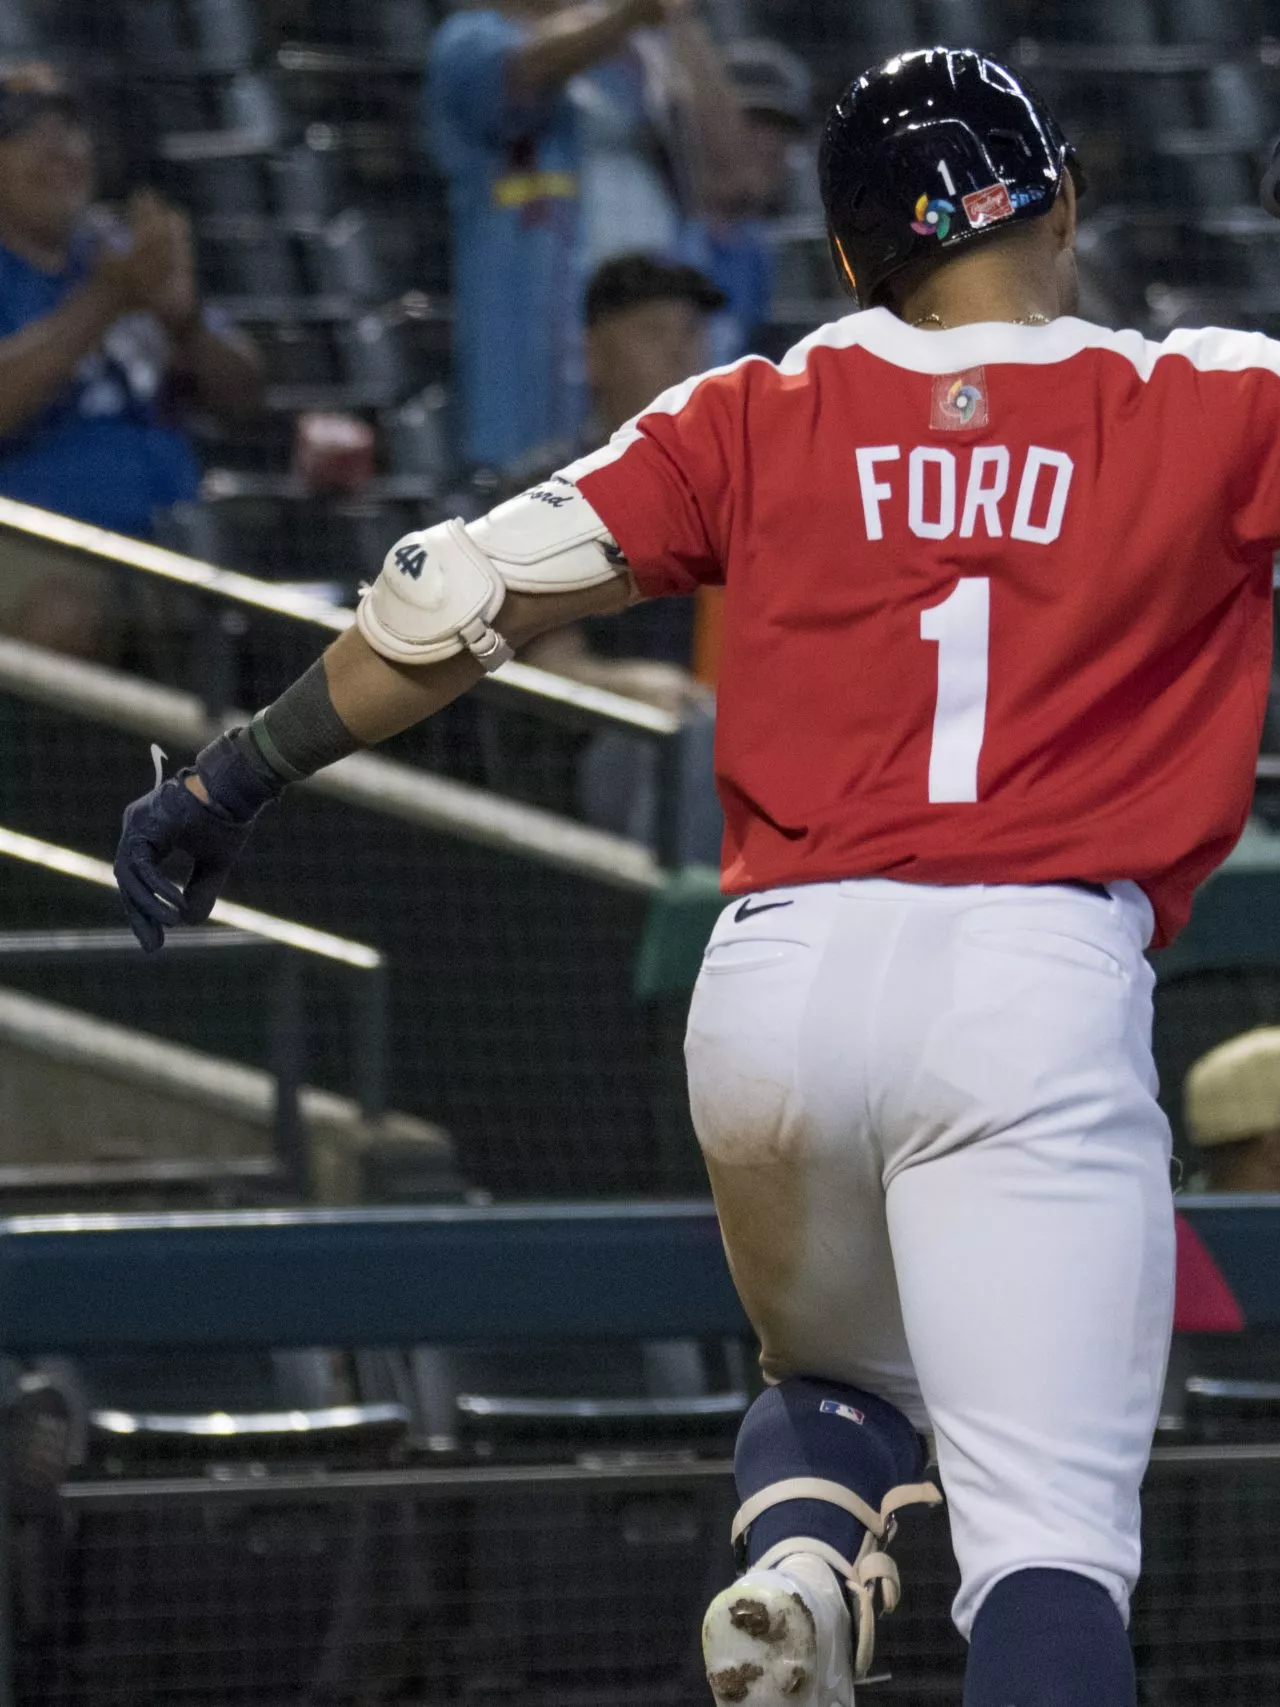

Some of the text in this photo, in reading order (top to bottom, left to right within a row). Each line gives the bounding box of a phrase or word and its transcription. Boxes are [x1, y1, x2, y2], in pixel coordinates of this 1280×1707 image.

[937, 160, 957, 197] 1
[855, 444, 1075, 545] FORD
[920, 576, 990, 803] 1
